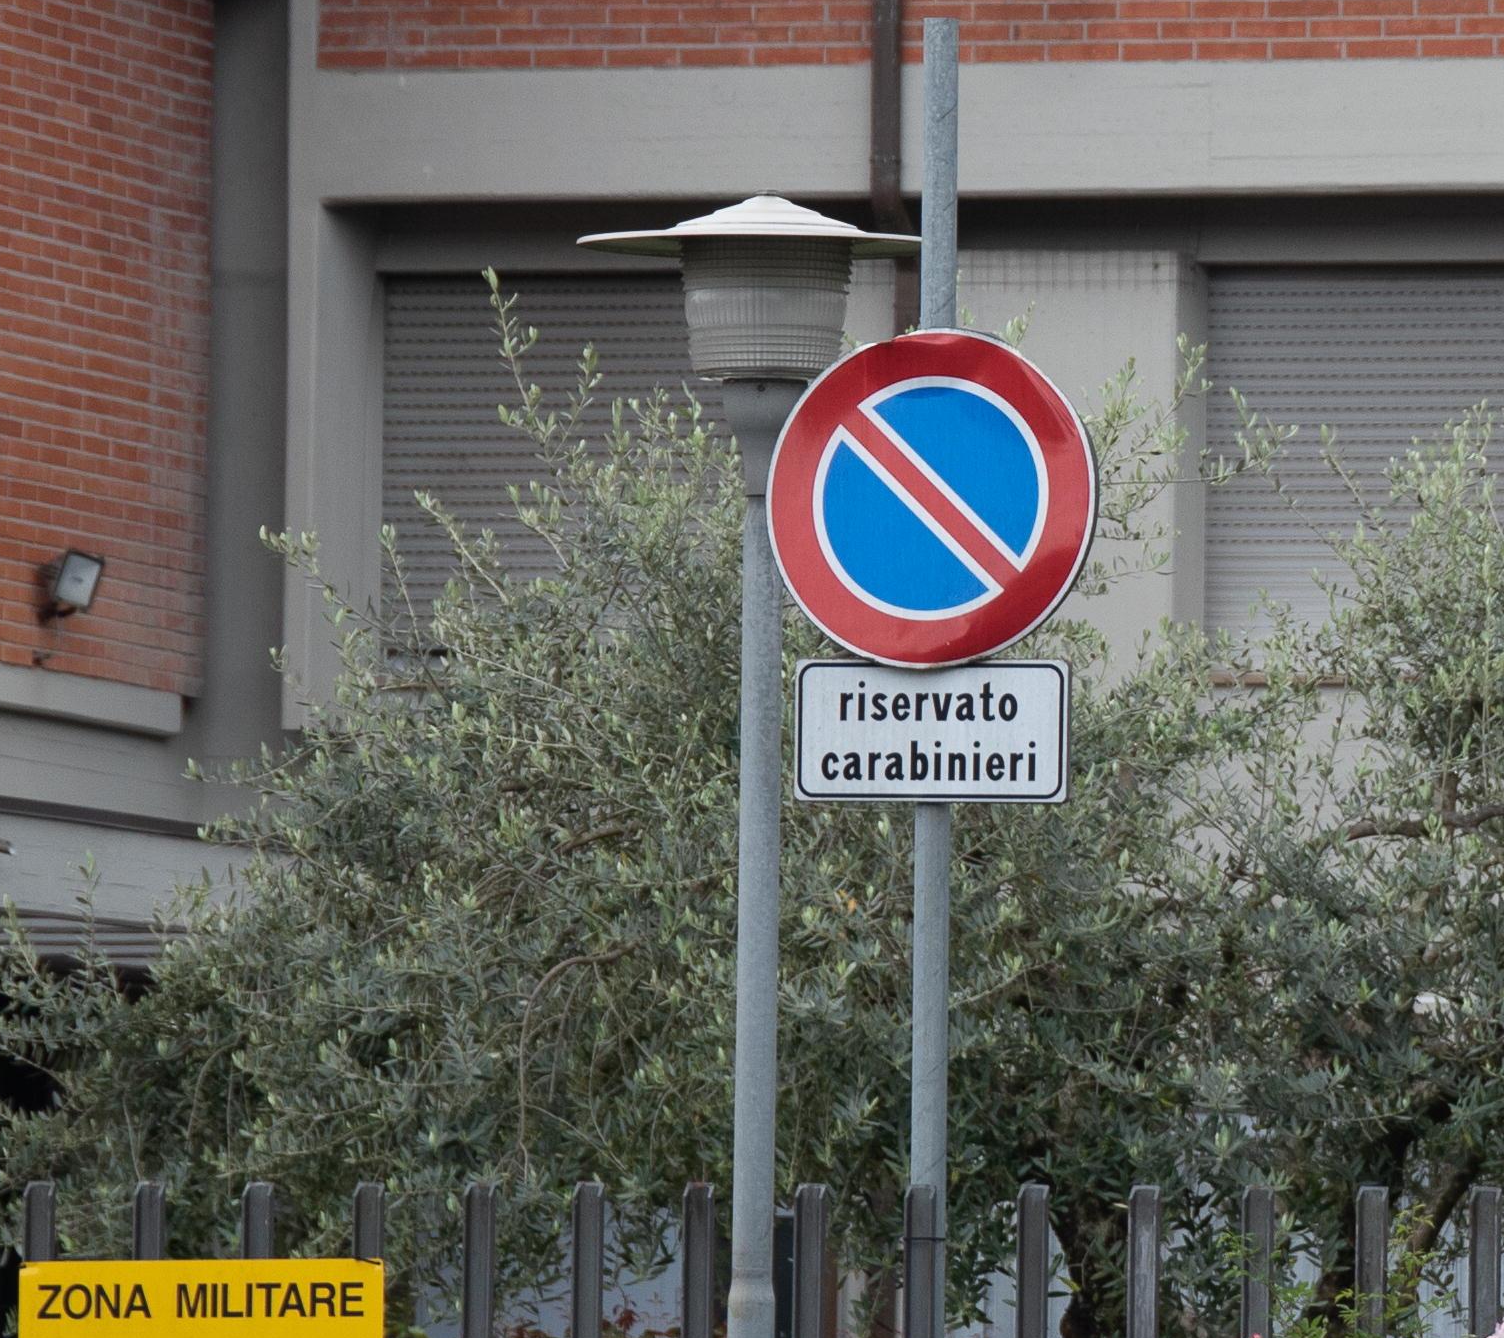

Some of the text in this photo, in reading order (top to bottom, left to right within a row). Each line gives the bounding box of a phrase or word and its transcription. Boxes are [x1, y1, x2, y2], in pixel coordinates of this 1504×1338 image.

[839, 680, 1018, 722] riservato
[821, 740, 1037, 782] carabinieri
[36, 1281, 365, 1320] ZONA MILITARE
